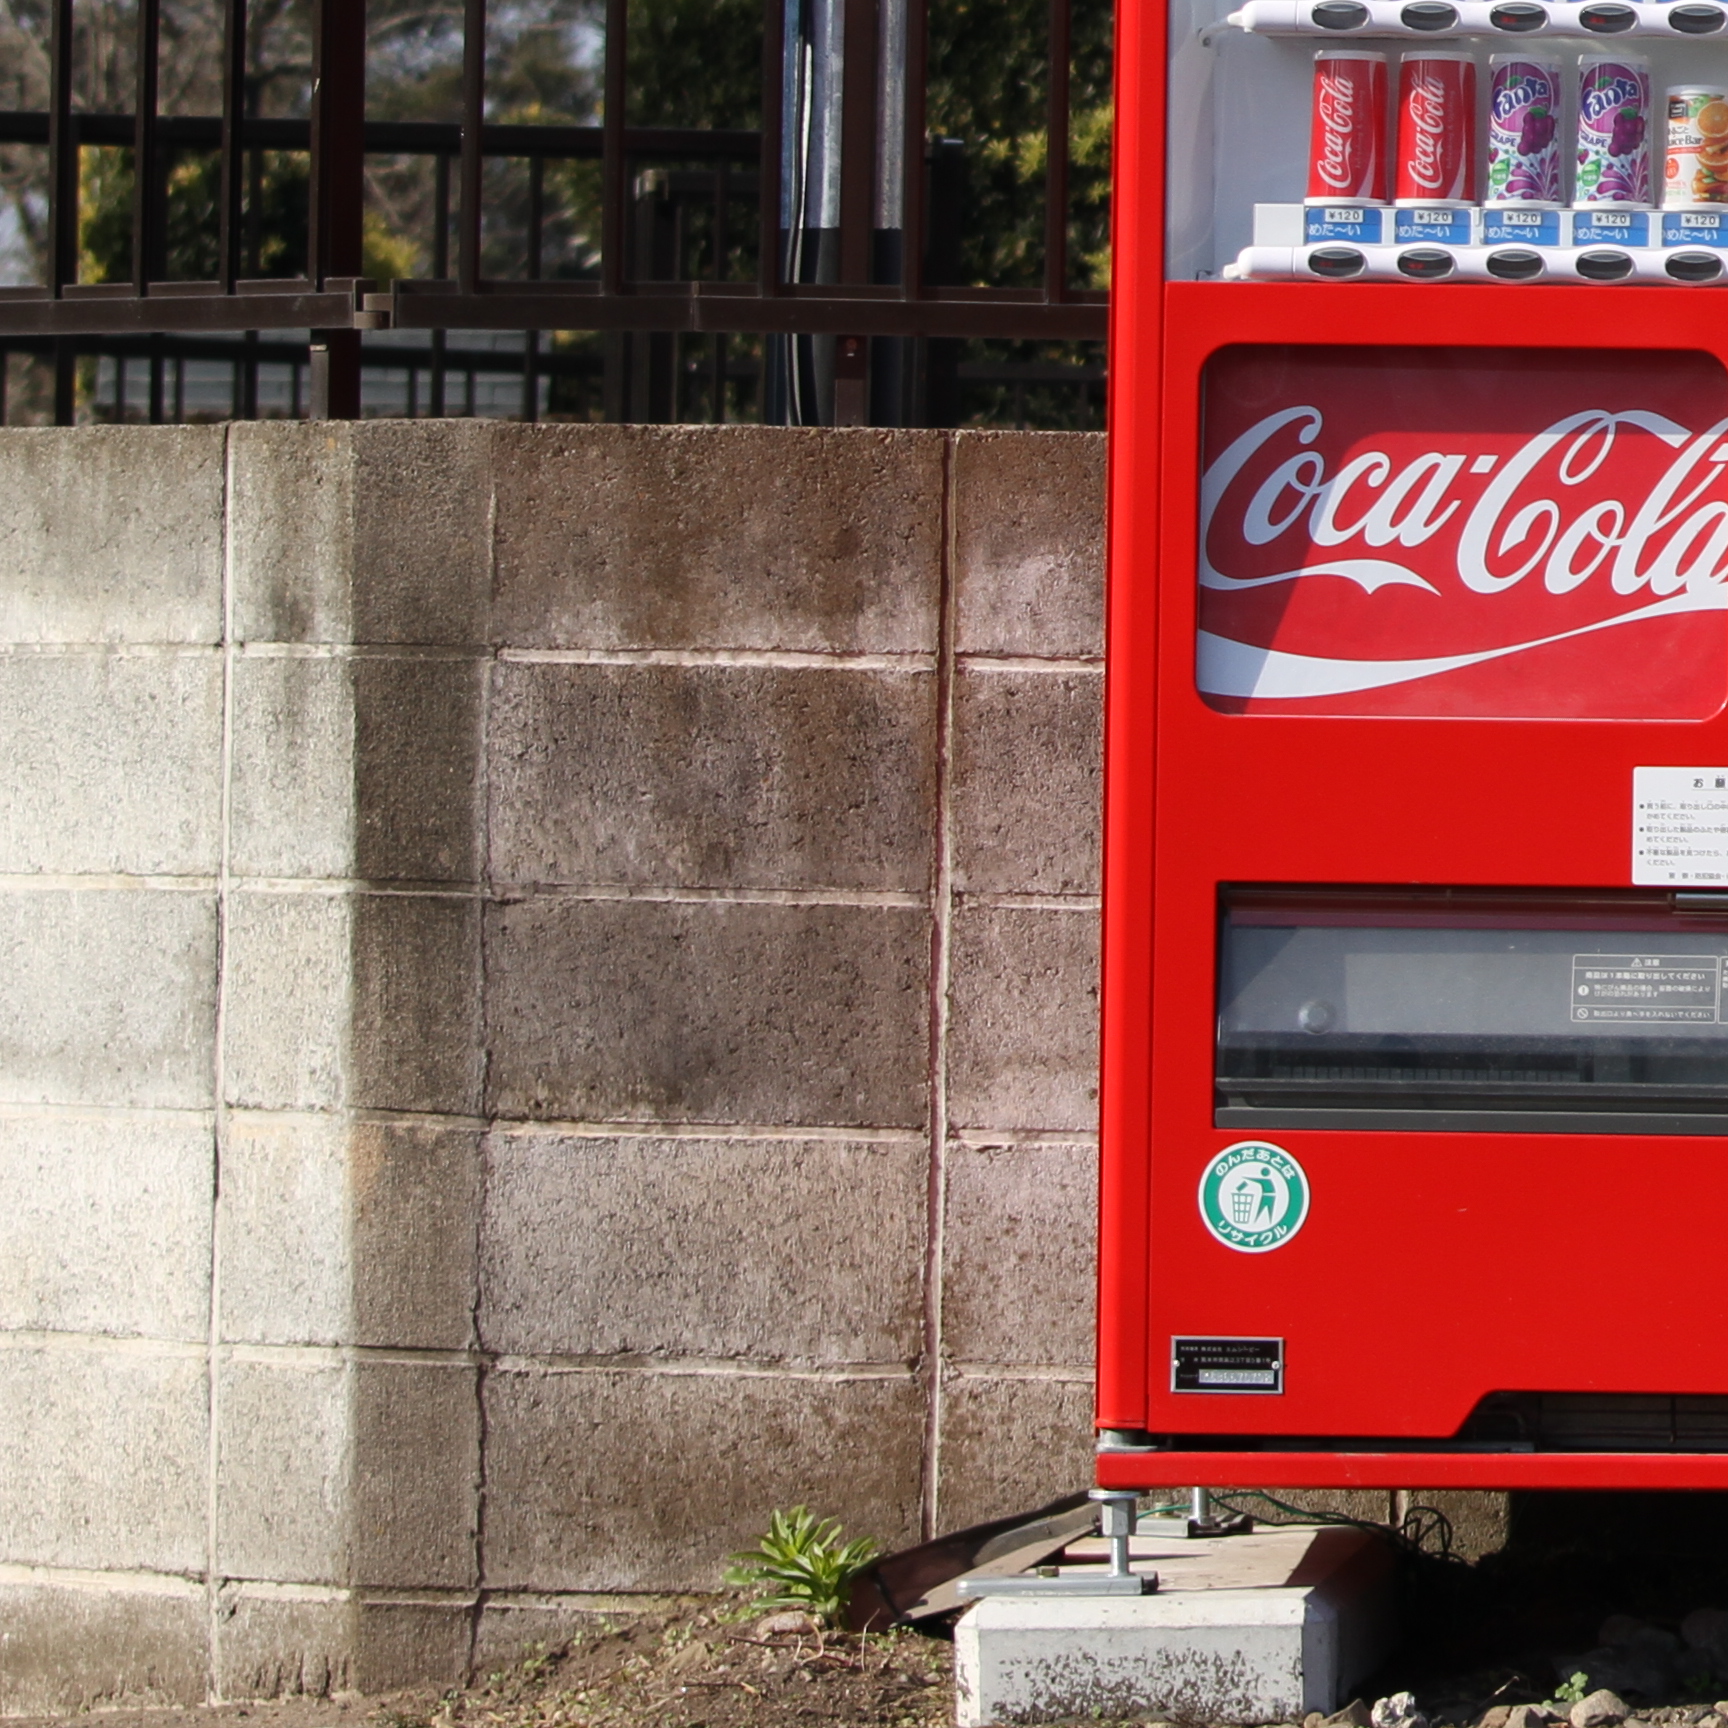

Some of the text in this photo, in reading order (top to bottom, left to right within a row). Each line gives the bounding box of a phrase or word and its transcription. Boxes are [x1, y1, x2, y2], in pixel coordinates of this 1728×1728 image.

[1493, 75, 1548, 123] Fanta
[1582, 76, 1638, 124] Fanta
[1317, 70, 1354, 189] Coca-Cola
[1407, 70, 1445, 189] Coca-Cola
[1685, 135, 1703, 146] Bar
[1328, 211, 1360, 221] ¥120
[1416, 212, 1449, 223] ¥120
[1506, 213, 1538, 223] ¥120
[1595, 214, 1627, 224] ¥120
[1684, 215, 1717, 225] ¥120
[1215, 1147, 1296, 1180] のんだあとは
[1217, 1219, 1288, 1246] リサイクル
